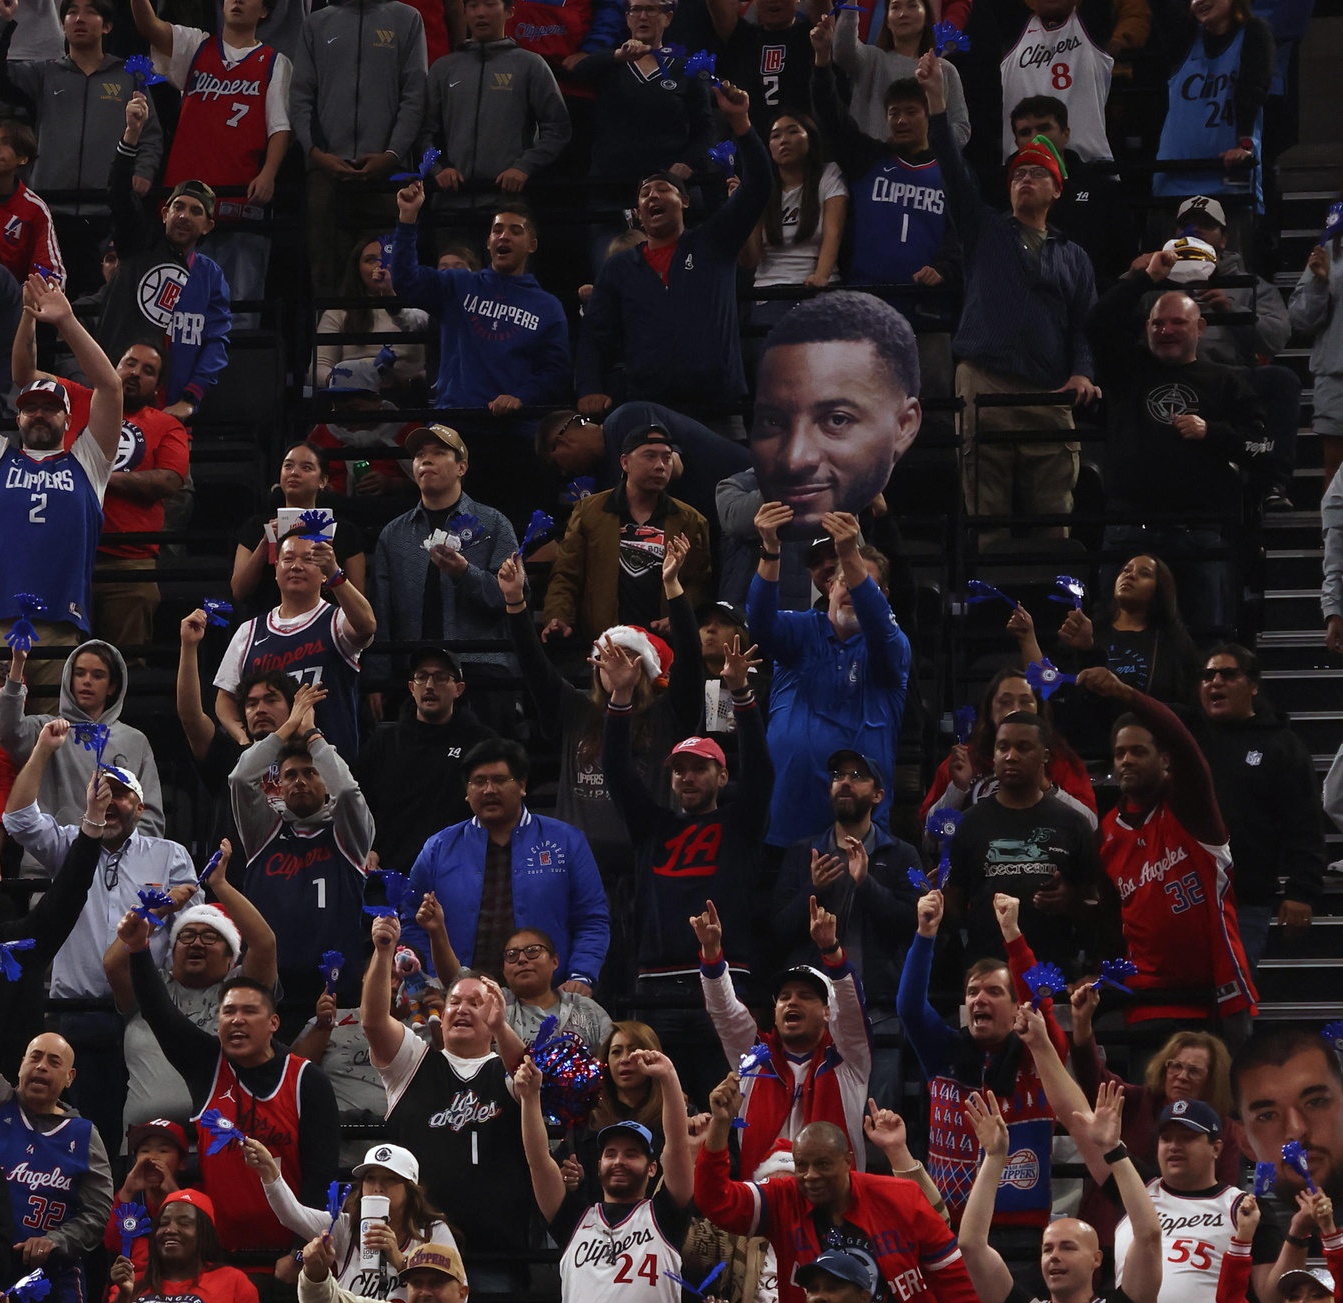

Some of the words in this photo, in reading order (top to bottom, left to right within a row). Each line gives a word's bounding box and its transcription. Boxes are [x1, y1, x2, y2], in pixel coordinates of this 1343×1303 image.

[187, 70, 261, 97] Clippers
[763, 75, 779, 106] 2
[1052, 63, 1072, 90] 8
[225, 102, 251, 128] 7
[872, 177, 945, 213] CLIPPERS
[1075, 191, 1089, 203] LA
[5, 215, 24, 240] LA
[900, 213, 909, 243] 1
[464, 294, 479, 313] LA
[478, 299, 540, 332] CLIPPERS
[5, 467, 76, 493] CLIPPERS
[28, 493, 49, 524] 2
[447, 747, 462, 759] LA
[531, 839, 565, 867] CLIPPERS
[653, 823, 723, 878] LA
[1117, 874, 1138, 901] Los
[1136, 847, 1187, 883] Angeles
[311, 879, 327, 909] 1
[1164, 872, 1206, 915] 32
[428, 1102, 502, 1131] angeles
[470, 1130, 479, 1165] 1
[959, 1134, 973, 1152] LA
[6, 1154, 72, 1192] Angeles
[22, 1195, 67, 1232] 32
[613, 1252, 661, 1286] 24
[1167, 1240, 1216, 1271] 55
